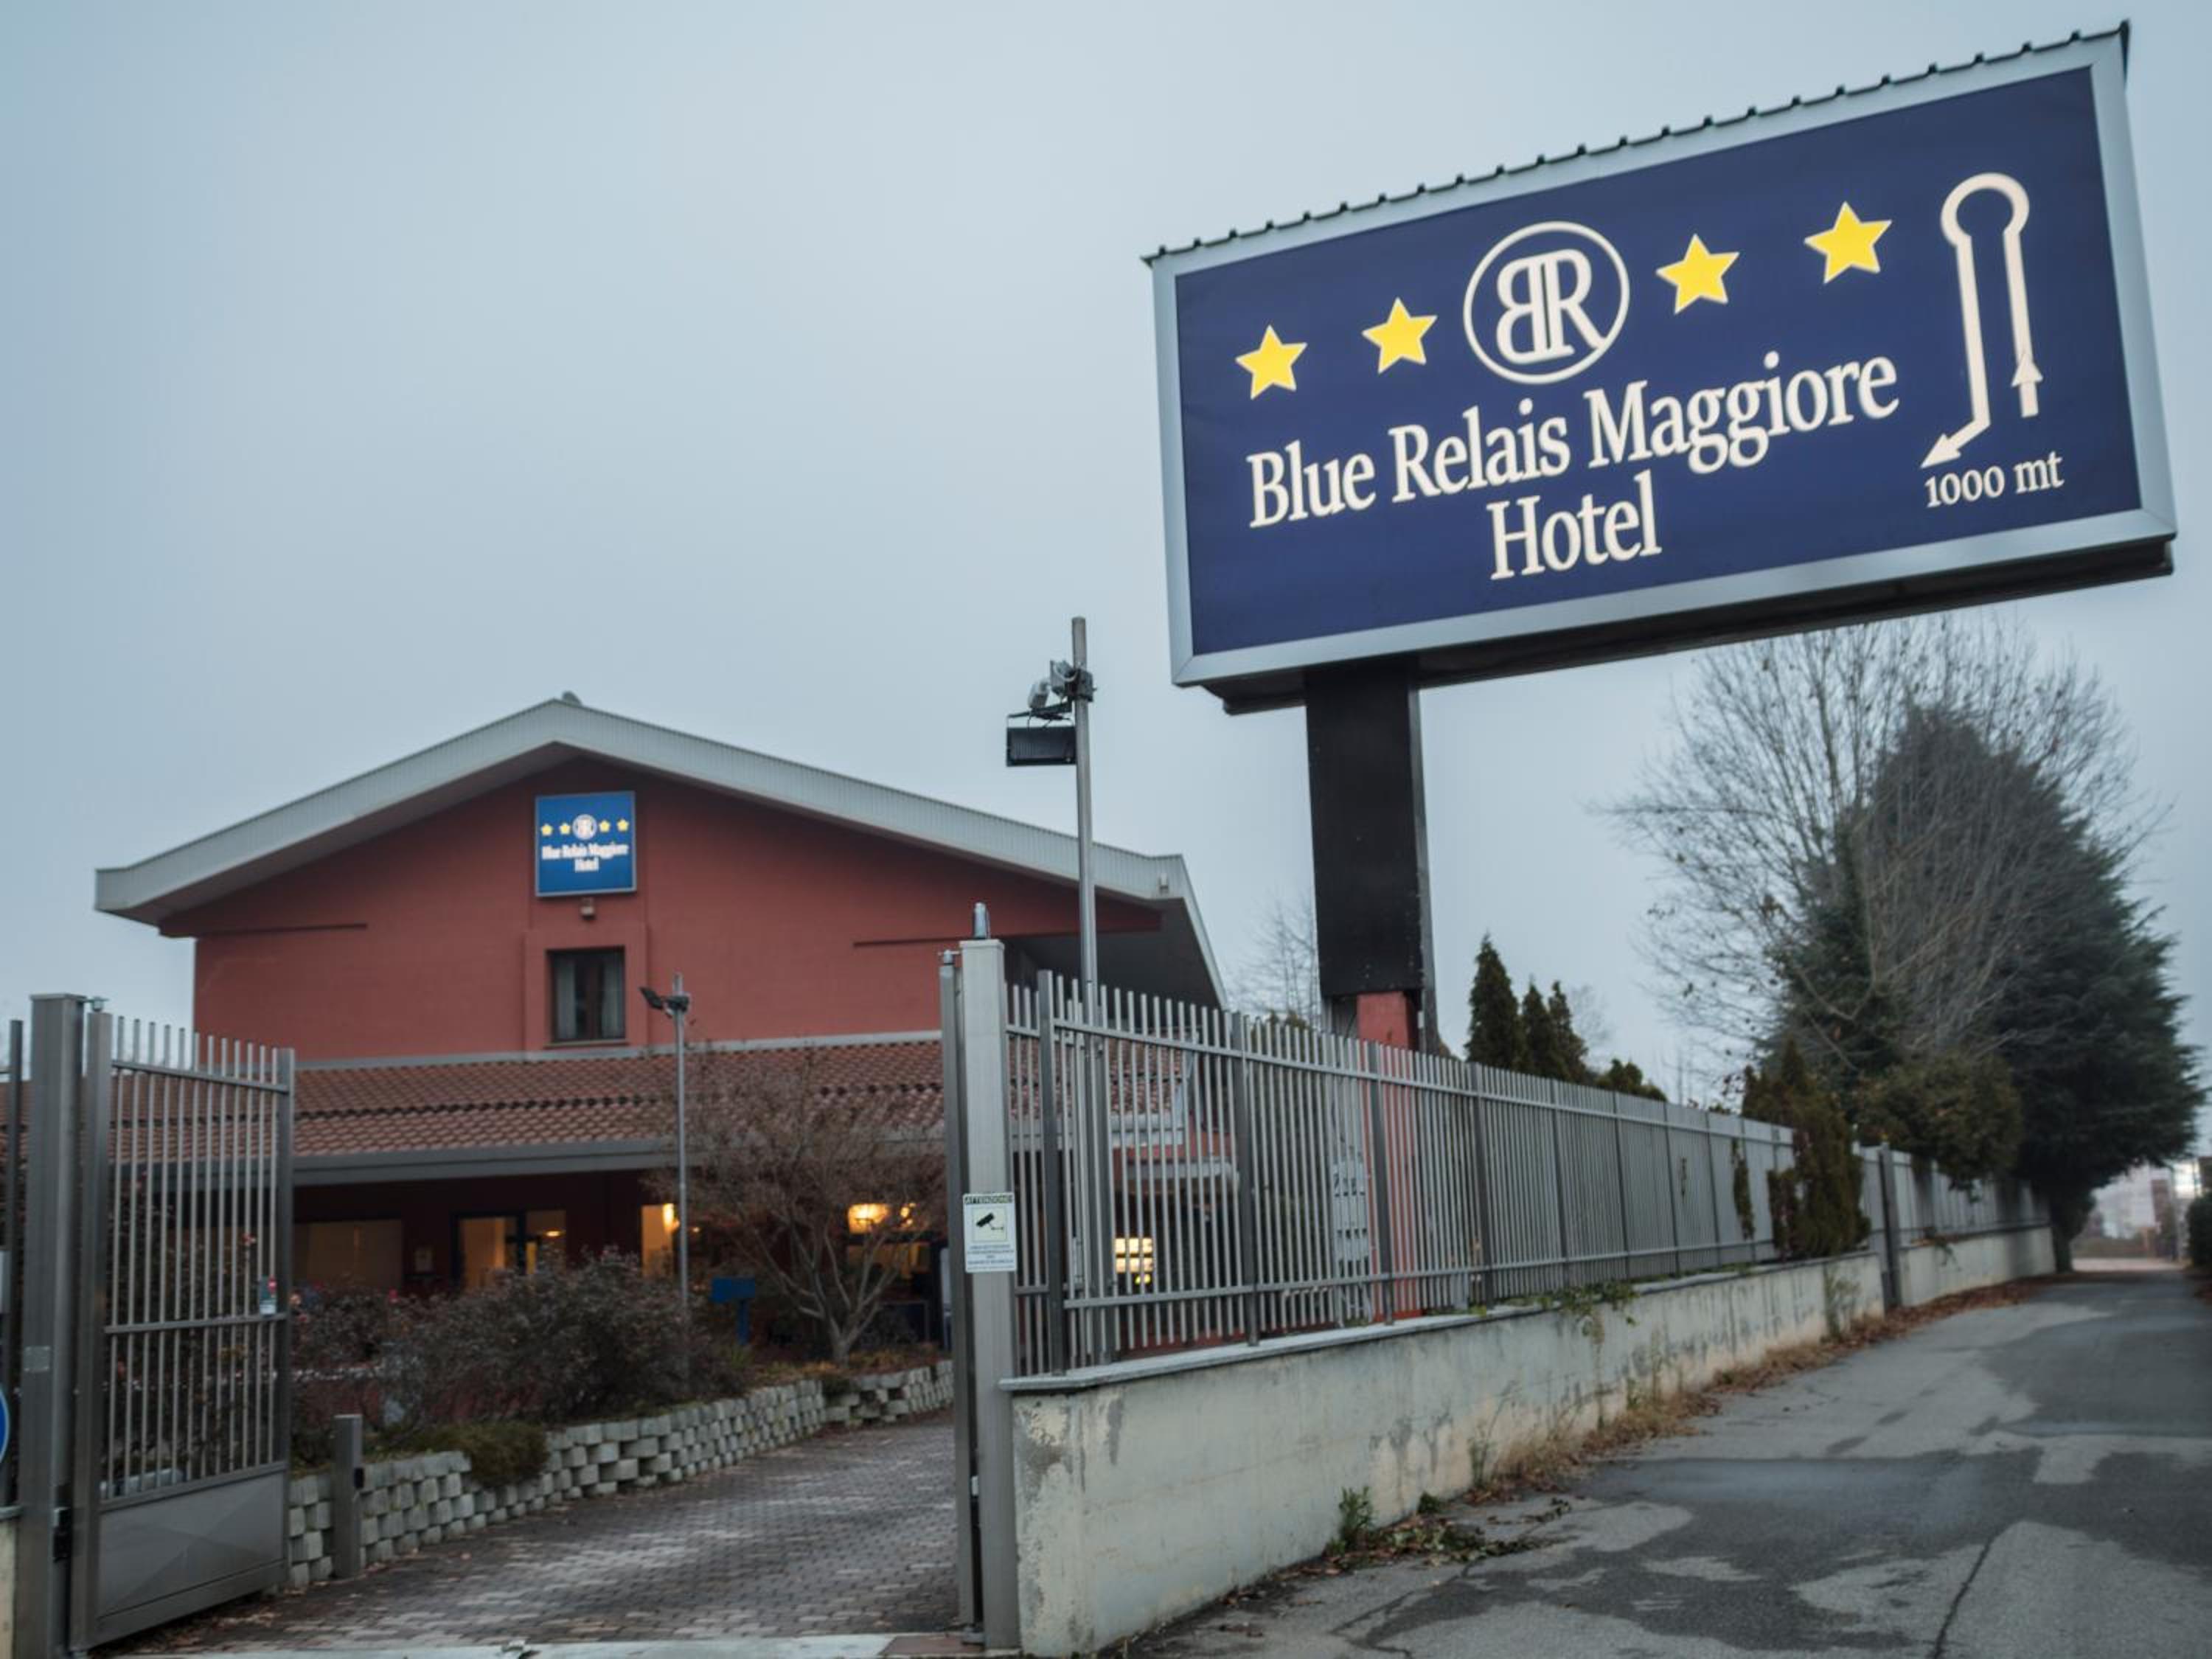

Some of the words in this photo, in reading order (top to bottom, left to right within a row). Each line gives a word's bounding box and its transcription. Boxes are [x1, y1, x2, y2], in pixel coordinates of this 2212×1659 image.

[1245, 439, 1377, 529] Blue
[1387, 397, 1571, 504] Relais
[1582, 351, 1900, 475] Maggiore
[1924, 466, 2006, 508] 1000
[2013, 451, 2065, 494] mt
[1485, 469, 1663, 581] Hotel
